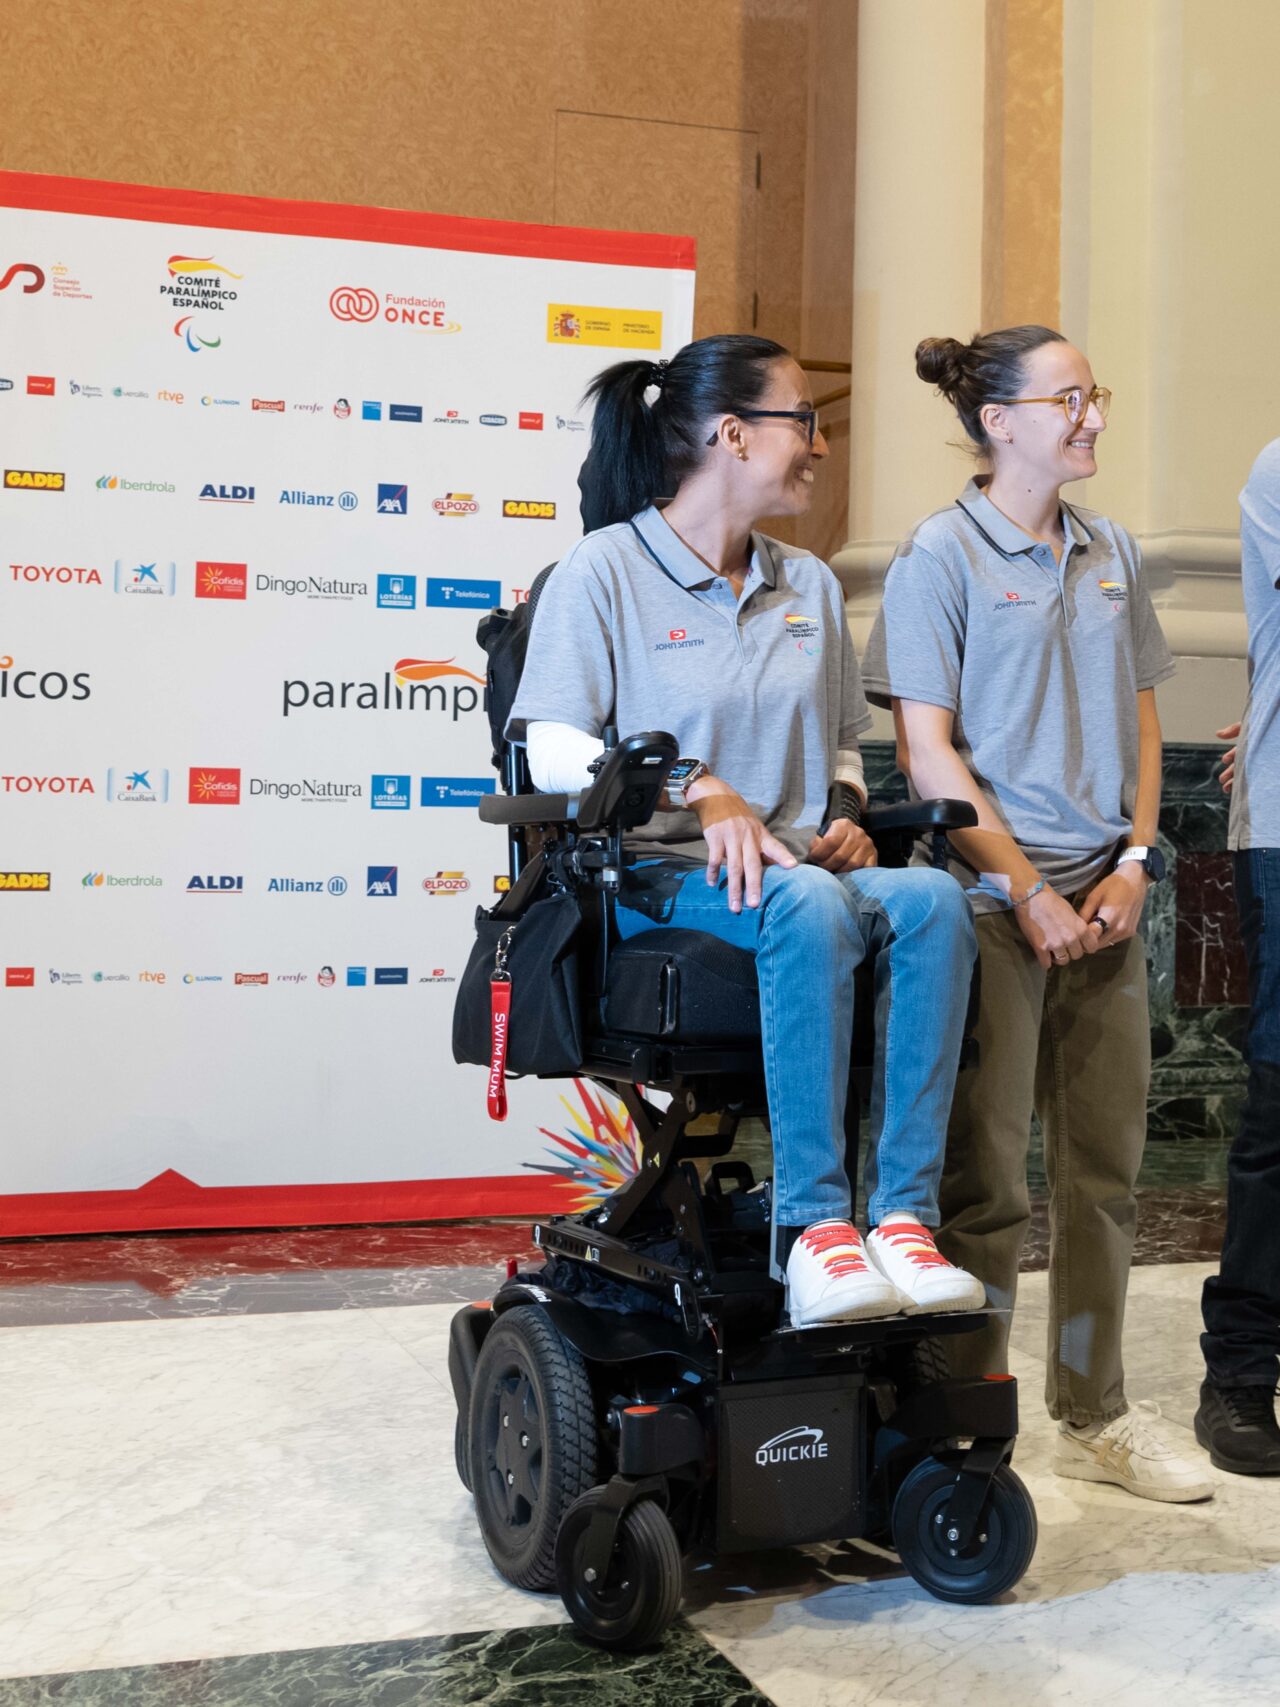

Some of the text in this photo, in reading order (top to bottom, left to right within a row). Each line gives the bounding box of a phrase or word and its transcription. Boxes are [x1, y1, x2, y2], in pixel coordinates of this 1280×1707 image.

[177, 276, 221, 288] COMITÉ
[160, 285, 238, 300] PARALÍMPICO
[172, 297, 224, 310] ESPAÑOL
[385, 293, 446, 309] Fundación
[384, 307, 445, 327] ONCE
[158, 389, 184, 404] rtve
[253, 401, 284, 411] Pascual
[293, 402, 324, 414] renfe
[6, 471, 64, 489] GADIS
[120, 479, 176, 493] Iberdrola
[199, 484, 255, 500] ALDI
[279, 489, 335, 507] Allianz
[377, 498, 403, 513] AXA
[504, 502, 555, 518] GADIS
[10, 565, 102, 585] TOYOTA
[210, 576, 244, 586] Cofidis
[654, 638, 704, 651] JOHN SMITH
[2, 776, 95, 794] TOYOTA
[203, 781, 238, 791] Cofidis
[106, 875, 163, 887] Iberdrola
[187, 876, 243, 889] ALDI
[268, 878, 324, 892] Allianz
[367, 881, 393, 895] AXA
[139, 970, 166, 984] rtve
[236, 974, 267, 982] Pascual
[277, 973, 308, 984] renfe
[489, 1013, 506, 1097] SWIM MUM
[755, 1443, 828, 1466] QUICKIE
